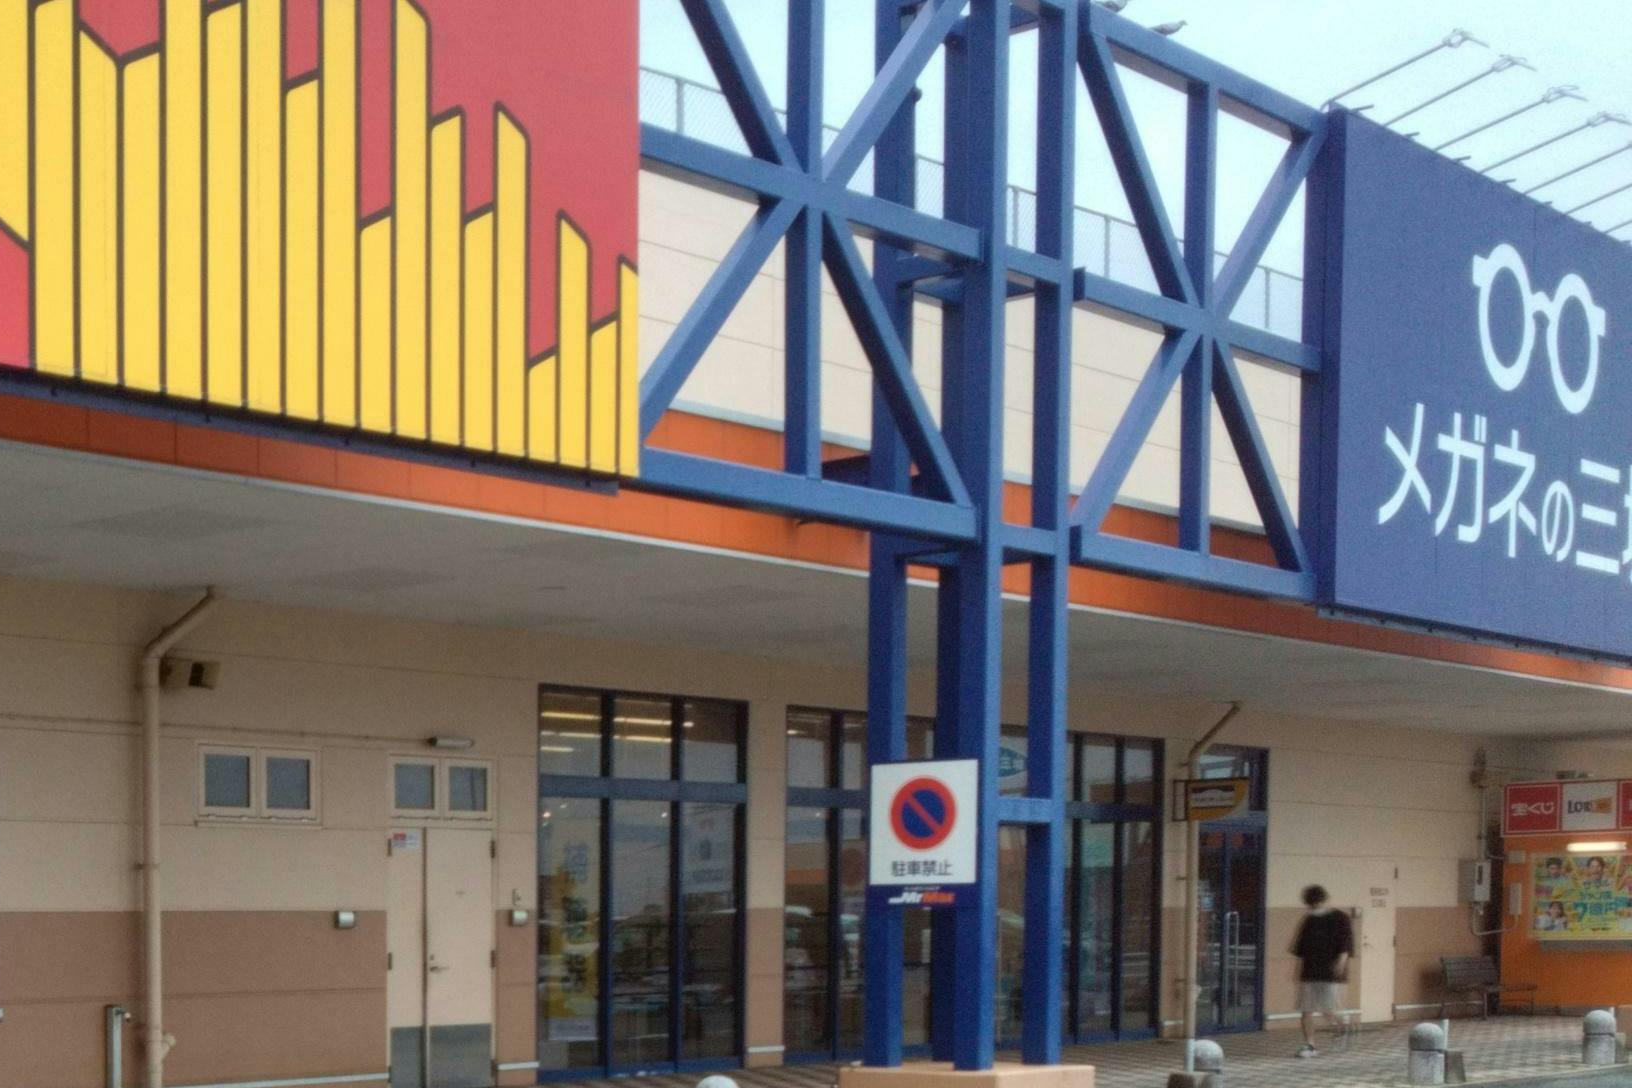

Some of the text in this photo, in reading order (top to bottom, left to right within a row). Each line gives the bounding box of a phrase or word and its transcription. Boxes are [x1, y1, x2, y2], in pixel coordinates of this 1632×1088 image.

[1378, 402, 1632, 596] メガネの三
[891, 860, 953, 877] 駐車禁止
